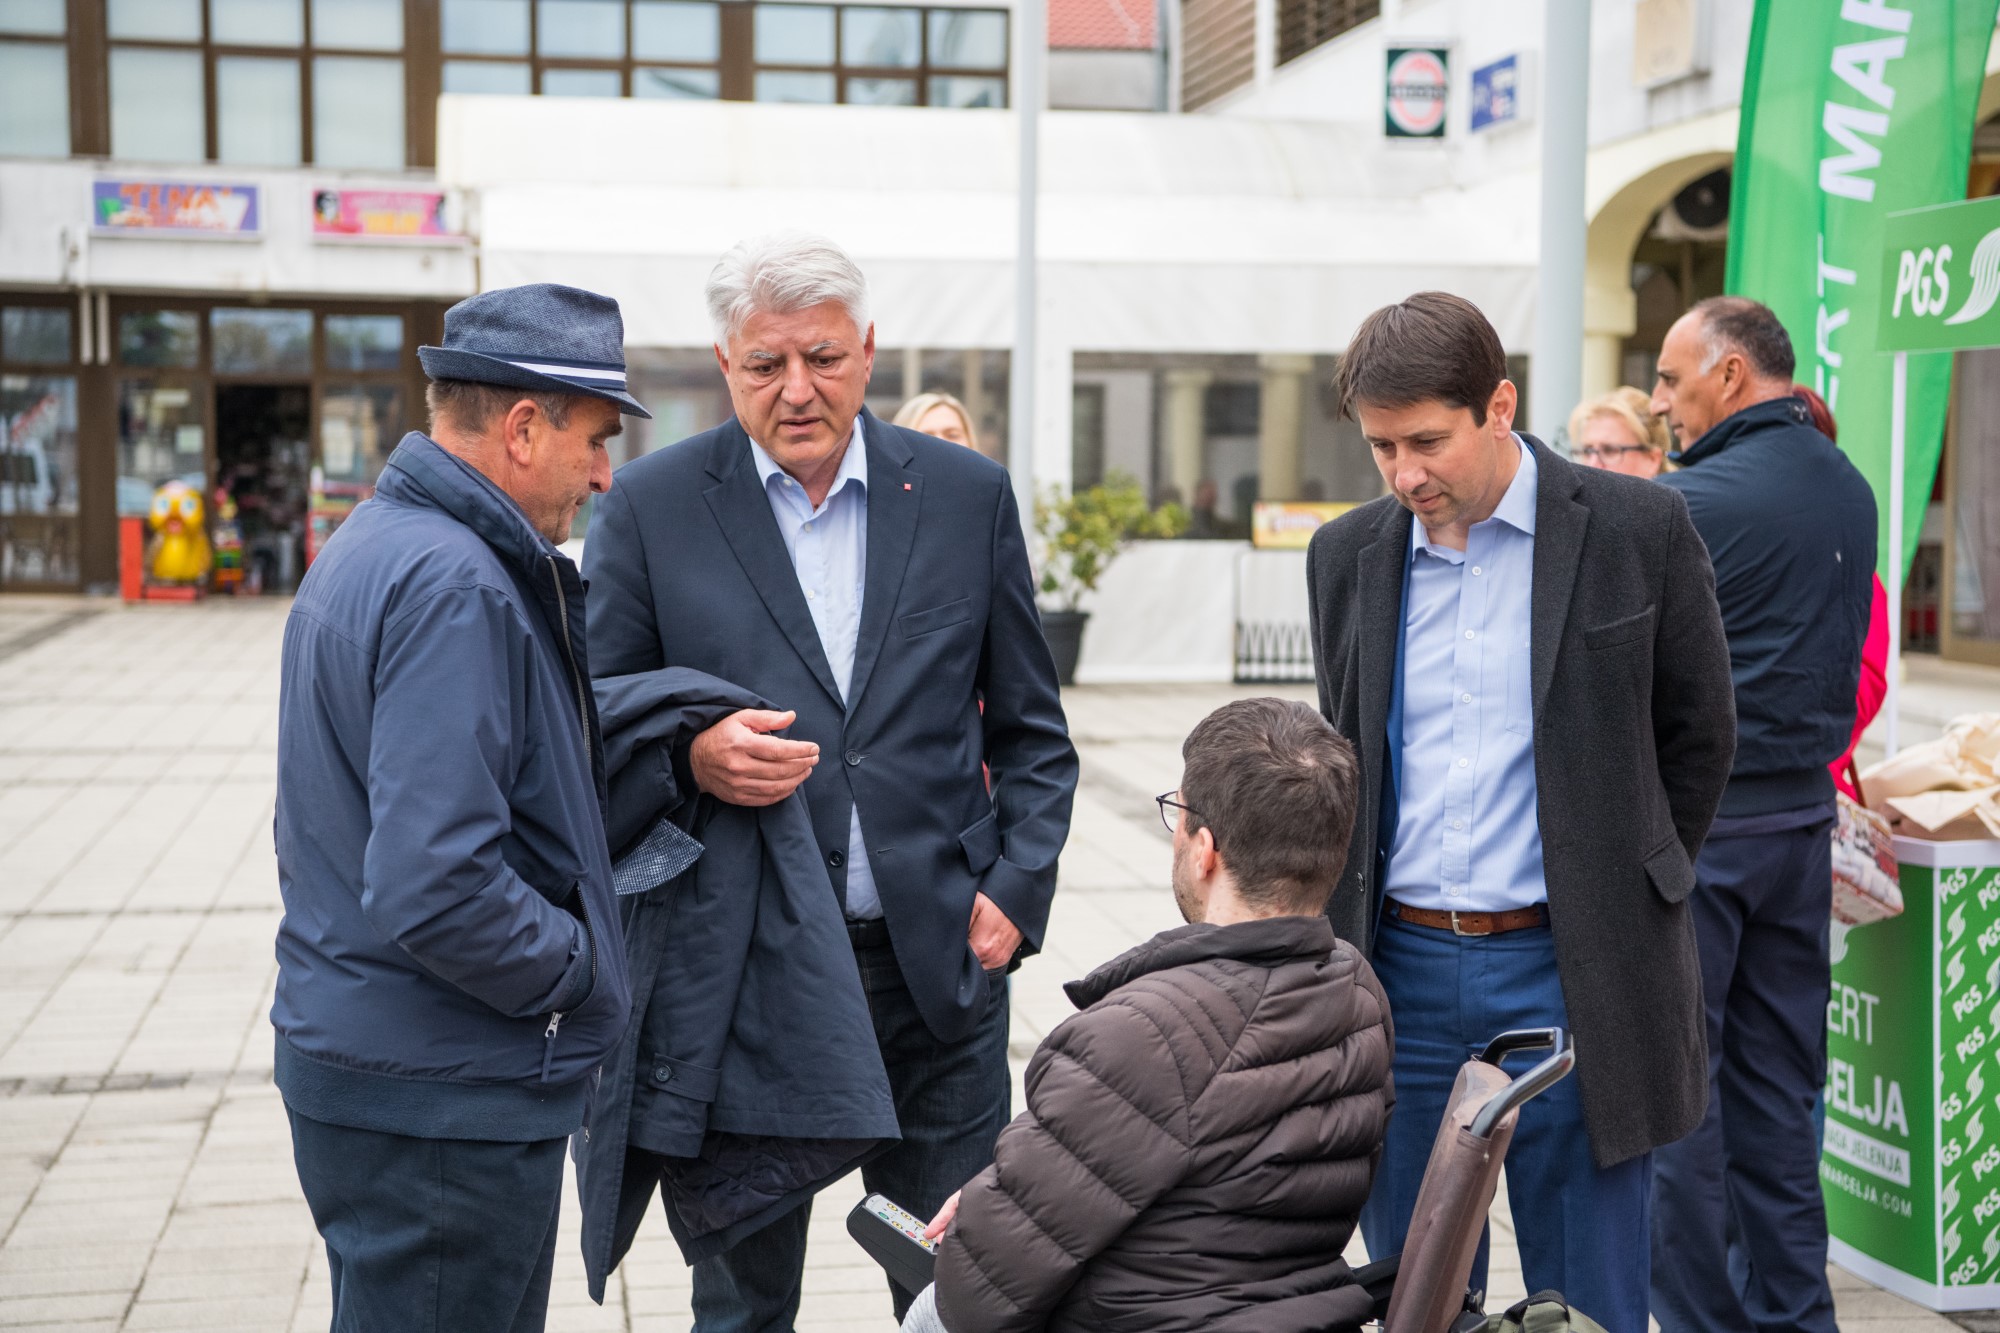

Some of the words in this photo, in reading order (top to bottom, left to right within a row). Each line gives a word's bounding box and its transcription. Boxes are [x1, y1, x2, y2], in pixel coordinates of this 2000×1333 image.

[1892, 244, 1953, 318] PGS
[1940, 867, 1968, 904] PGS
[1952, 984, 1983, 1023] PGS
[1956, 1025, 1986, 1064] PGS
[1972, 1144, 2000, 1183] PGS
